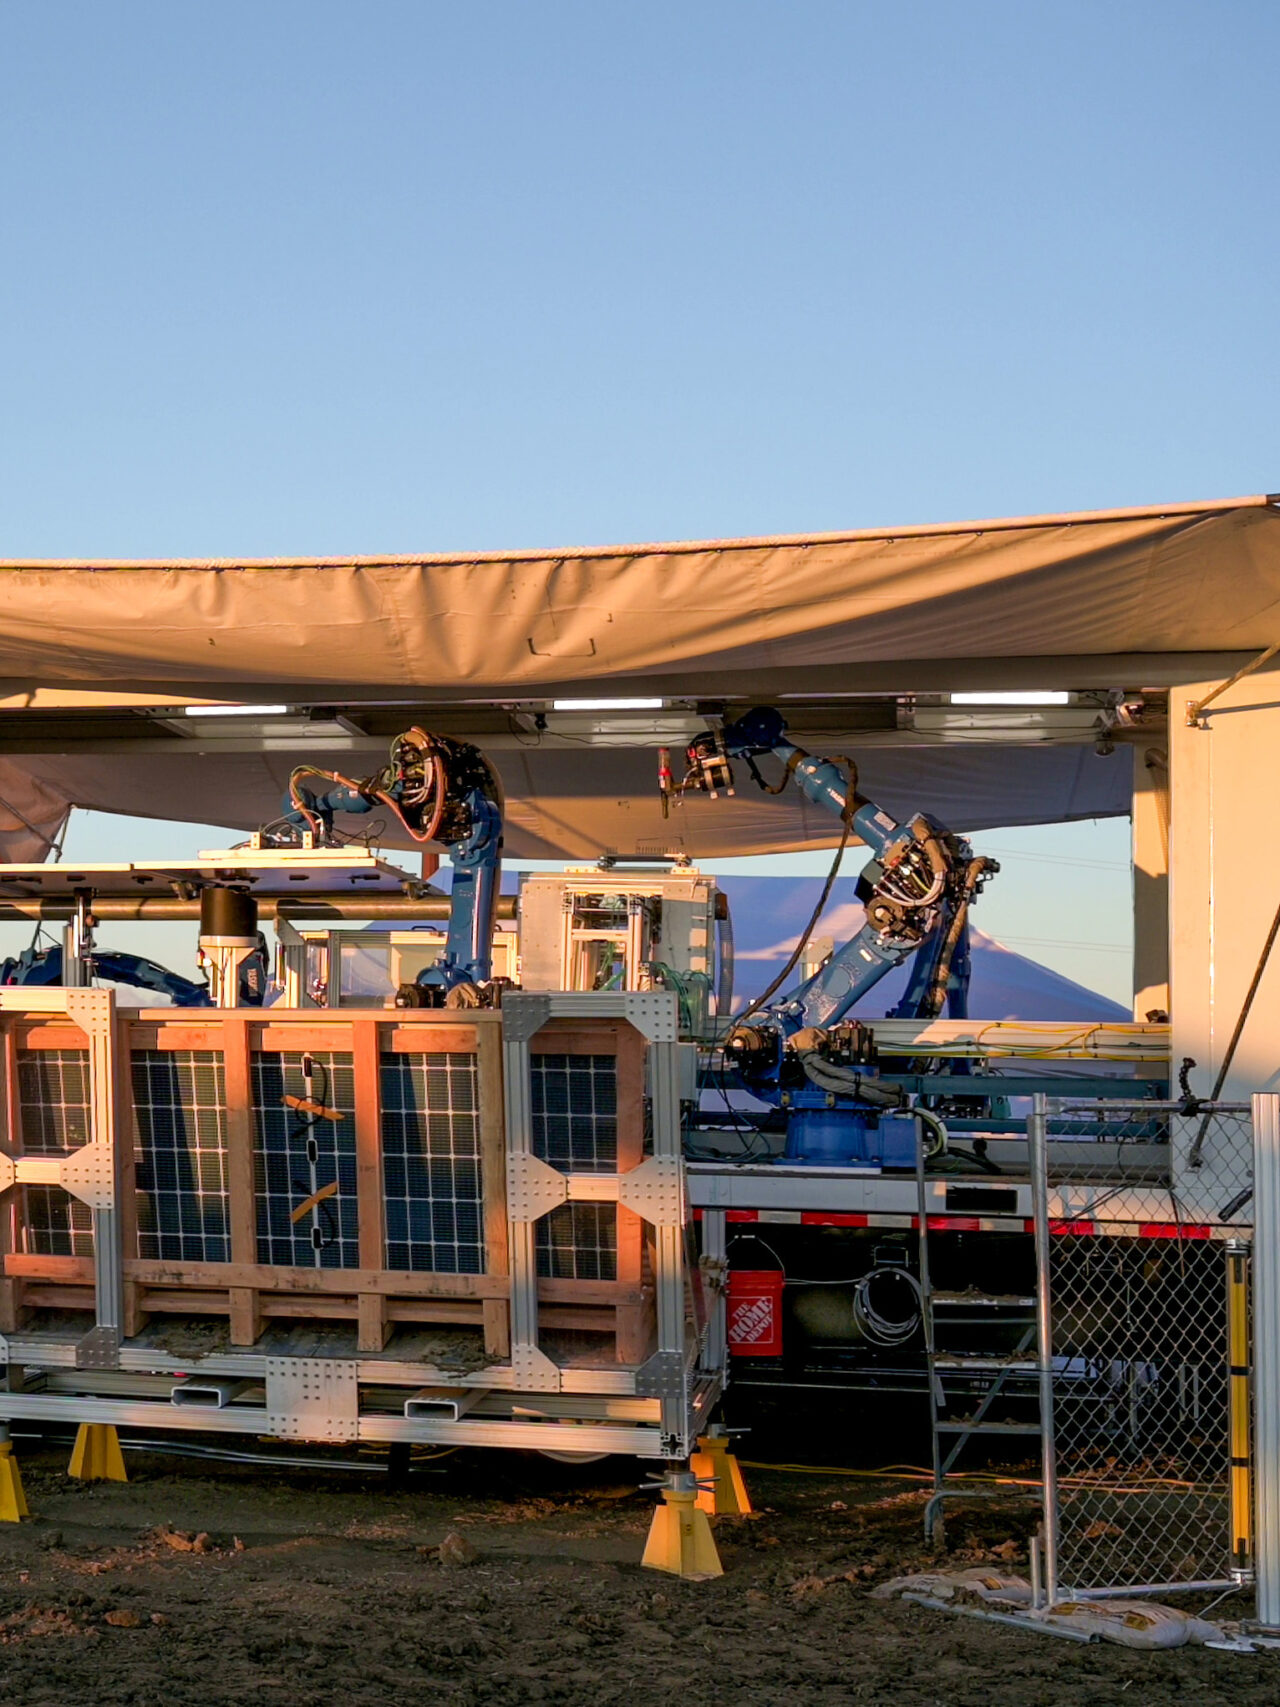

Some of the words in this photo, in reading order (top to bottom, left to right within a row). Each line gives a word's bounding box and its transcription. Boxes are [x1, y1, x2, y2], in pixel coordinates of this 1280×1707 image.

[729, 1297, 772, 1342] HOME
[732, 1302, 751, 1320] THE
[746, 1315, 772, 1342] DEPOT
